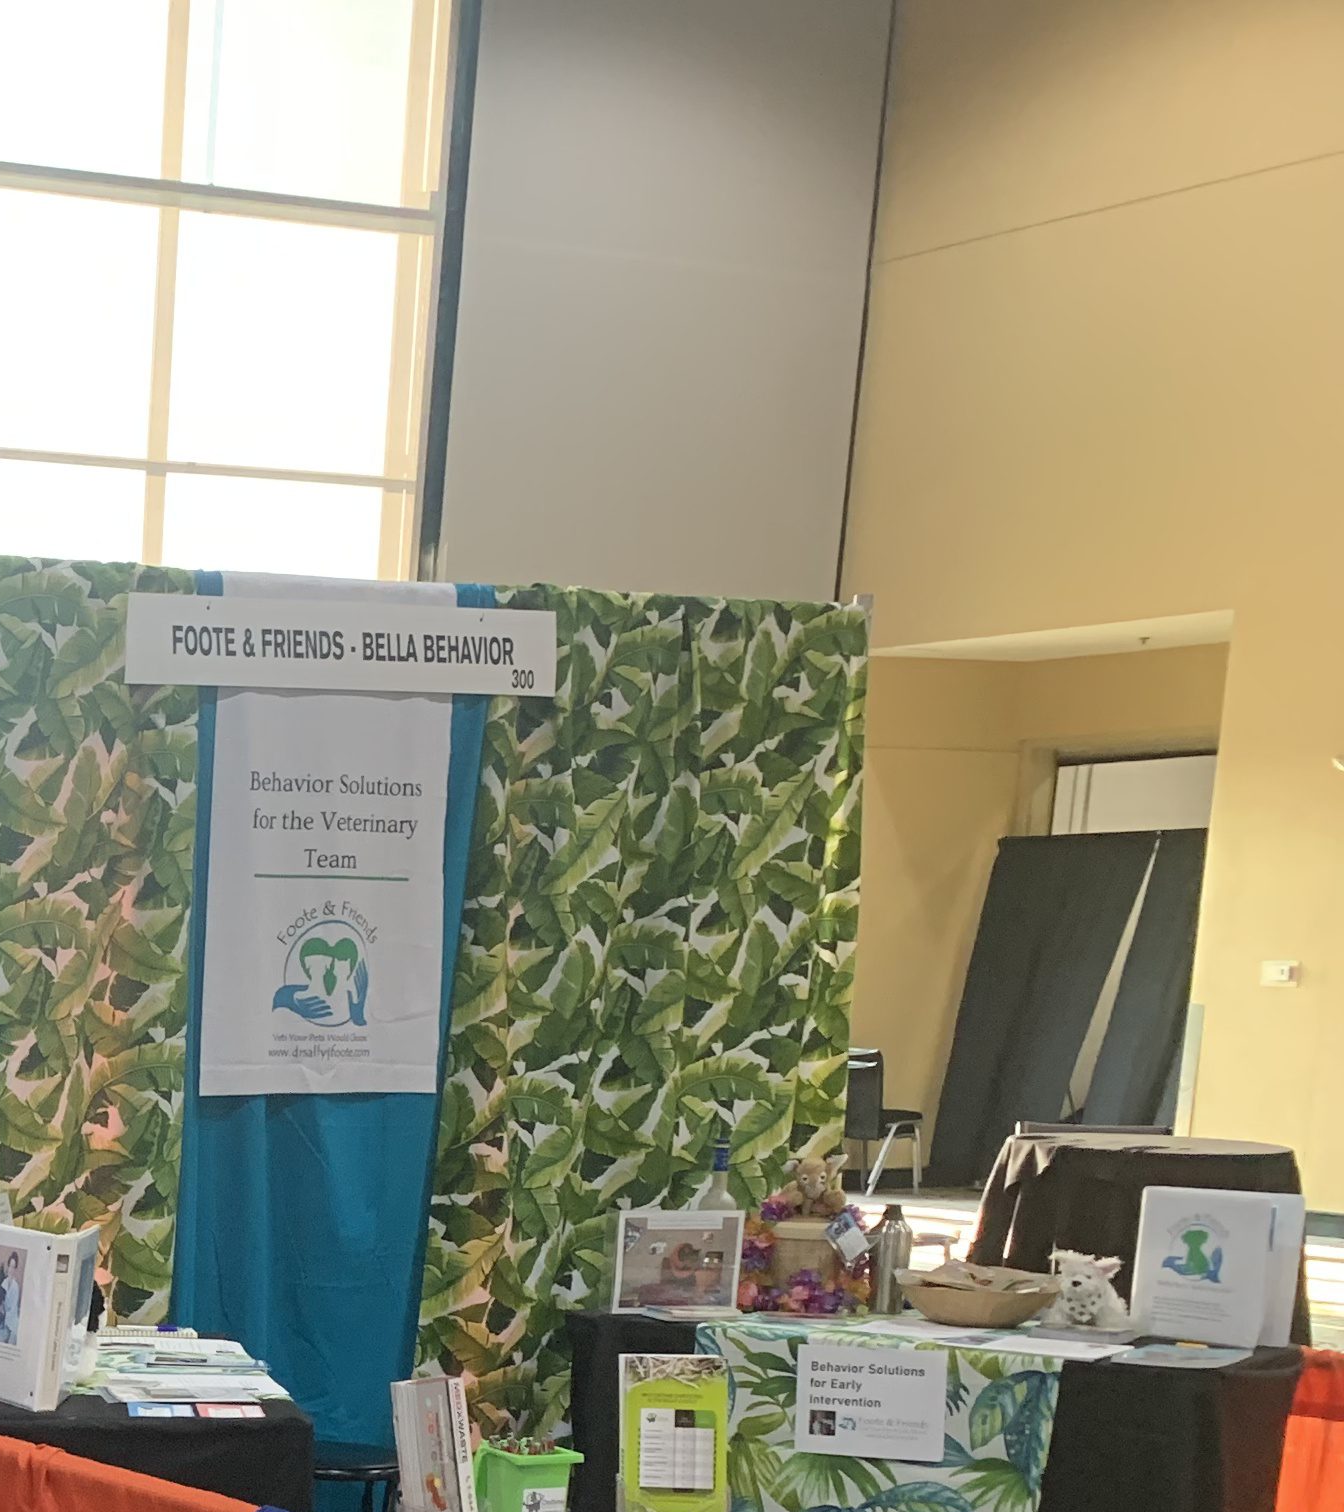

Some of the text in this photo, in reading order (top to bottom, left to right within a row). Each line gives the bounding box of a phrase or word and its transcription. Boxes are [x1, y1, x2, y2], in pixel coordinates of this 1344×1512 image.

[172, 625, 514, 665] FOOTE & FRIENDS BELLA BEHAVIOR
[512, 669, 535, 690] 300
[250, 771, 423, 798] Behavior Solutions
[253, 809, 418, 839] for the Veterinary
[304, 848, 357, 869] Team
[276, 901, 379, 946] Foote & Friends
[811, 1361, 925, 1377] Behavior Solutions
[810, 1378, 862, 1392] for Early
[809, 1394, 882, 1408] Intervention
